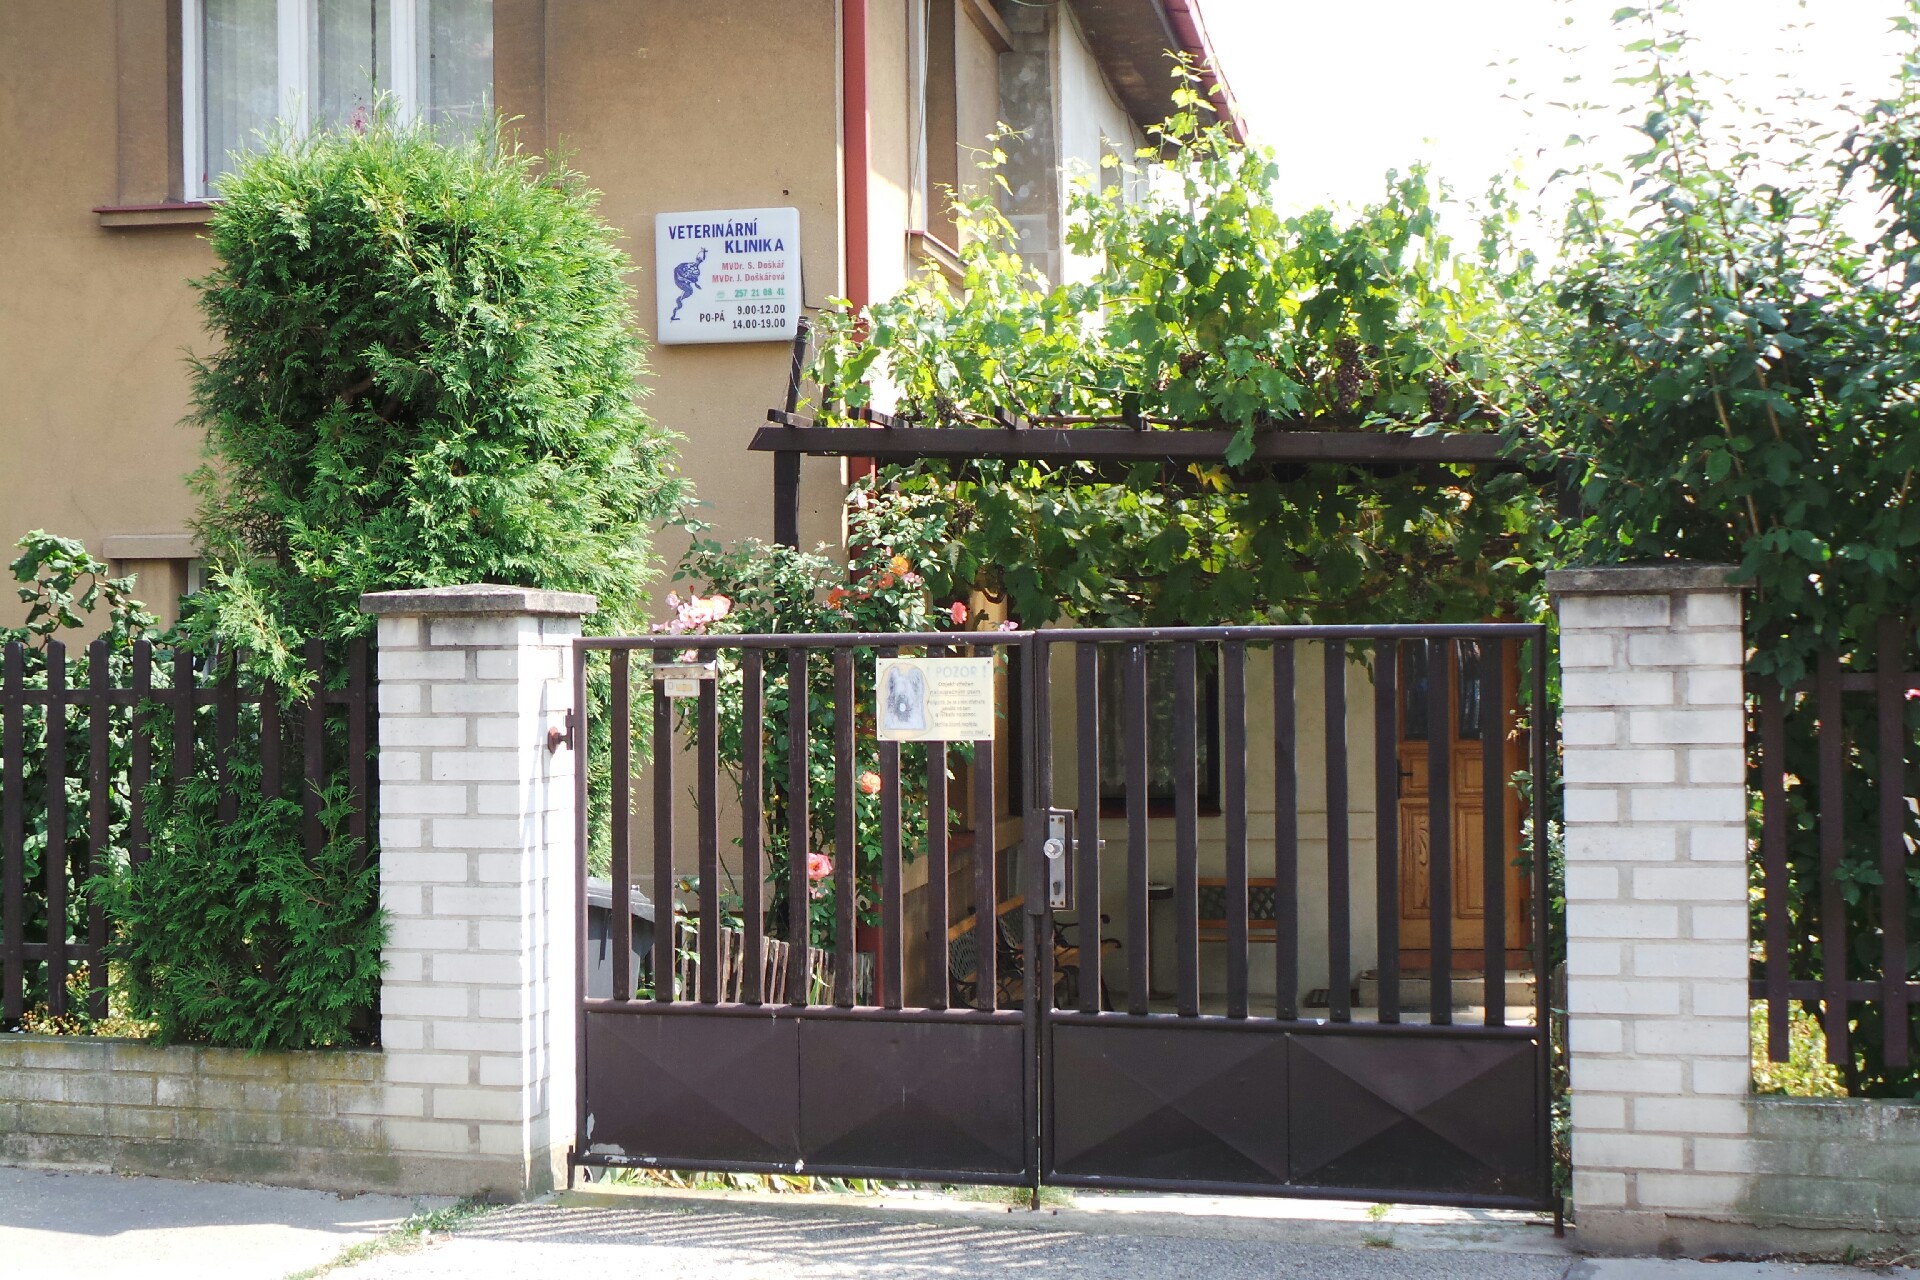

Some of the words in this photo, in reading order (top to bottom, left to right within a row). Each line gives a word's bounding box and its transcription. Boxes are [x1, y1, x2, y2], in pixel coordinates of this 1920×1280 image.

[669, 218, 758, 240] VETERINÁRNÍ
[725, 238, 784, 253] KLINIKA
[721, 262, 744, 271] MVDr.
[747, 261, 755, 270] S.
[712, 274, 735, 283] MVDr.
[736, 273, 743, 282] J.
[734, 289, 748, 298] 257
[751, 288, 760, 297] 21
[776, 287, 785, 296] 41
[737, 304, 785, 315] 9.00-12.00
[699, 310, 725, 322] PO-PÁ
[732, 318, 786, 329] 14.00-19.00
[936, 666, 977, 678] POZOR
